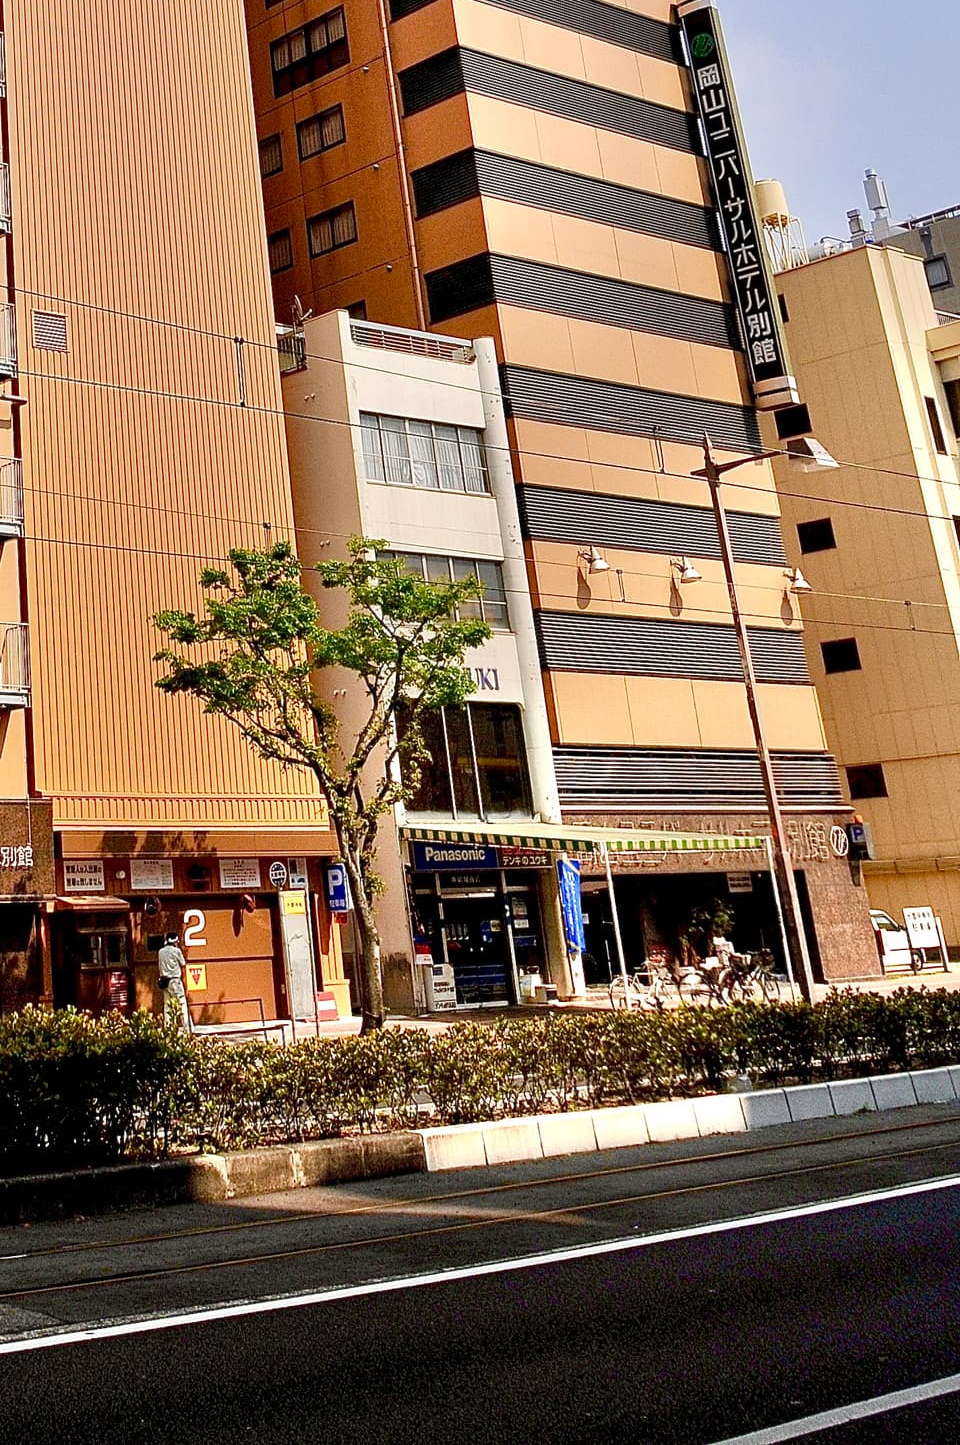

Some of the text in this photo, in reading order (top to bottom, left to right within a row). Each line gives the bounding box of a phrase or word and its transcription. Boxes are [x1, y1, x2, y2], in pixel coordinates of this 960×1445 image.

[696, 62, 777, 365] 岡山ユニバーサルホテル別館
[853, 826, 864, 841] P
[424, 846, 487, 862] Panasonic
[327, 869, 343, 896] P
[183, 909, 207, 947] 2
